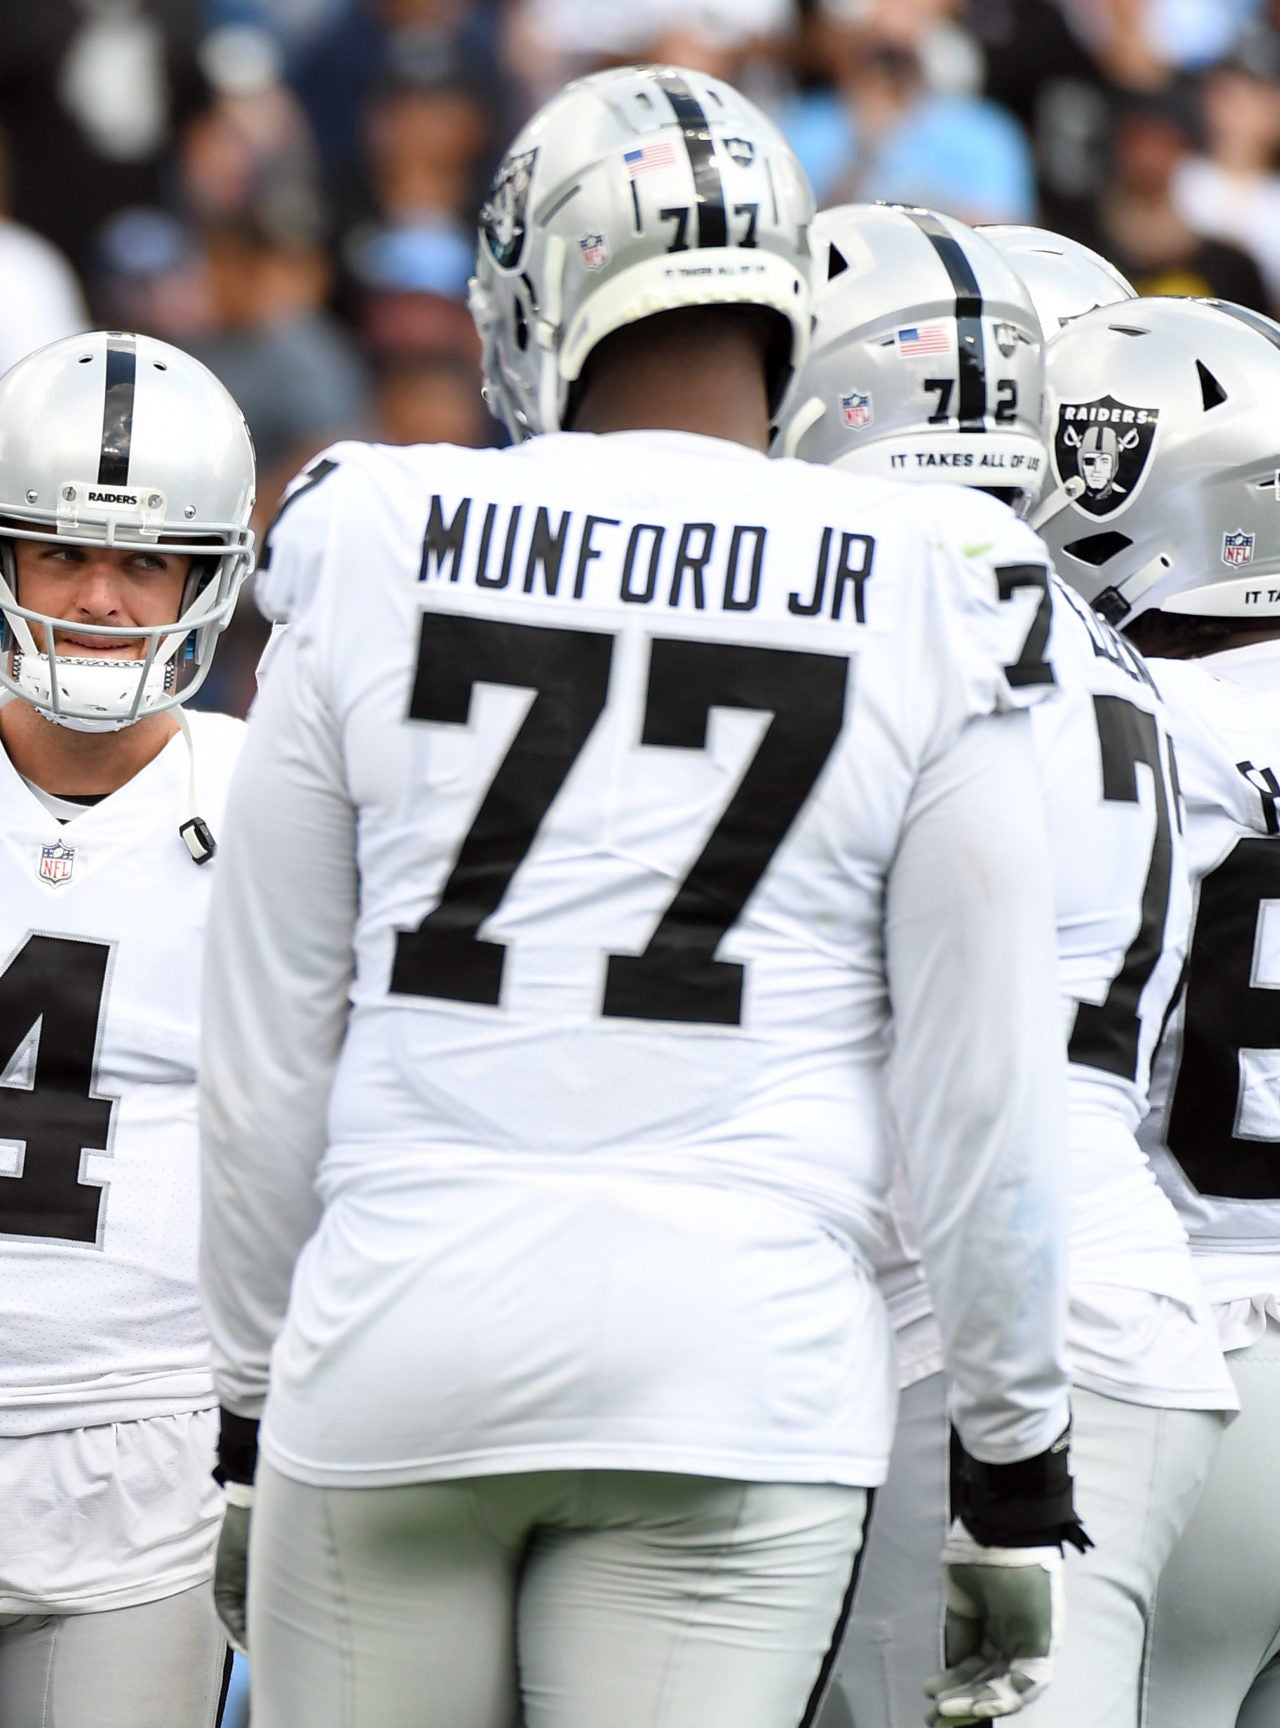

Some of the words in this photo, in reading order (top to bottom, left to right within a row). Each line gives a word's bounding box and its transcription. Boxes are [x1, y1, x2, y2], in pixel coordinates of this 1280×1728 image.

[1064, 406, 1149, 424] RAIDERS
[891, 454, 908, 468] IT
[916, 453, 973, 467] TAKES
[980, 454, 1006, 468] ALL
[1010, 455, 1025, 468] OF
[88, 491, 138, 505] RAIDERS
[419, 495, 767, 612] MUNFORD
[788, 527, 876, 624] JR
[1226, 547, 1249, 562] NFL
[1245, 590, 1263, 605] IT
[994, 563, 1056, 690] 7
[388, 611, 851, 1026] 77
[42, 860, 69, 878] NFL
[1066, 694, 1186, 1082] 7
